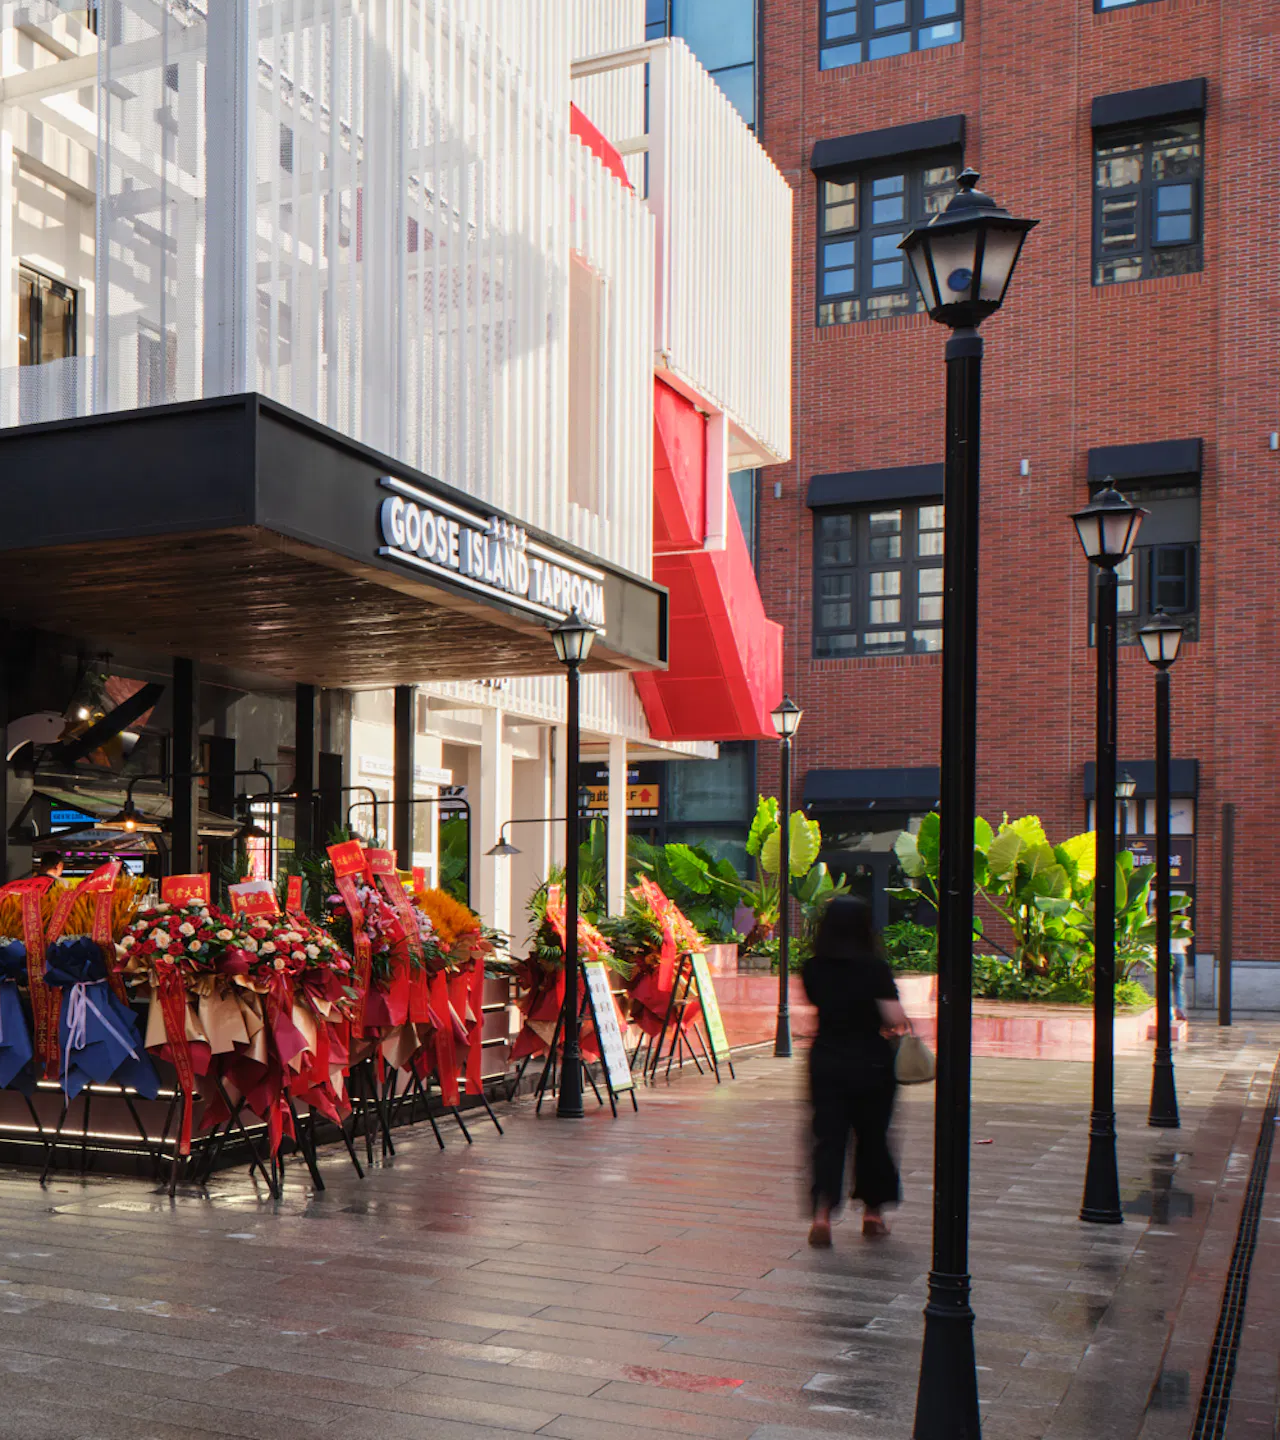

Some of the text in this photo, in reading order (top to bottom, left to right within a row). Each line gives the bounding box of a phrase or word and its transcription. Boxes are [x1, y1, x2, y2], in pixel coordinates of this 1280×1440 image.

[381, 495, 606, 625] GOOSE ISLAND TAPROOM
